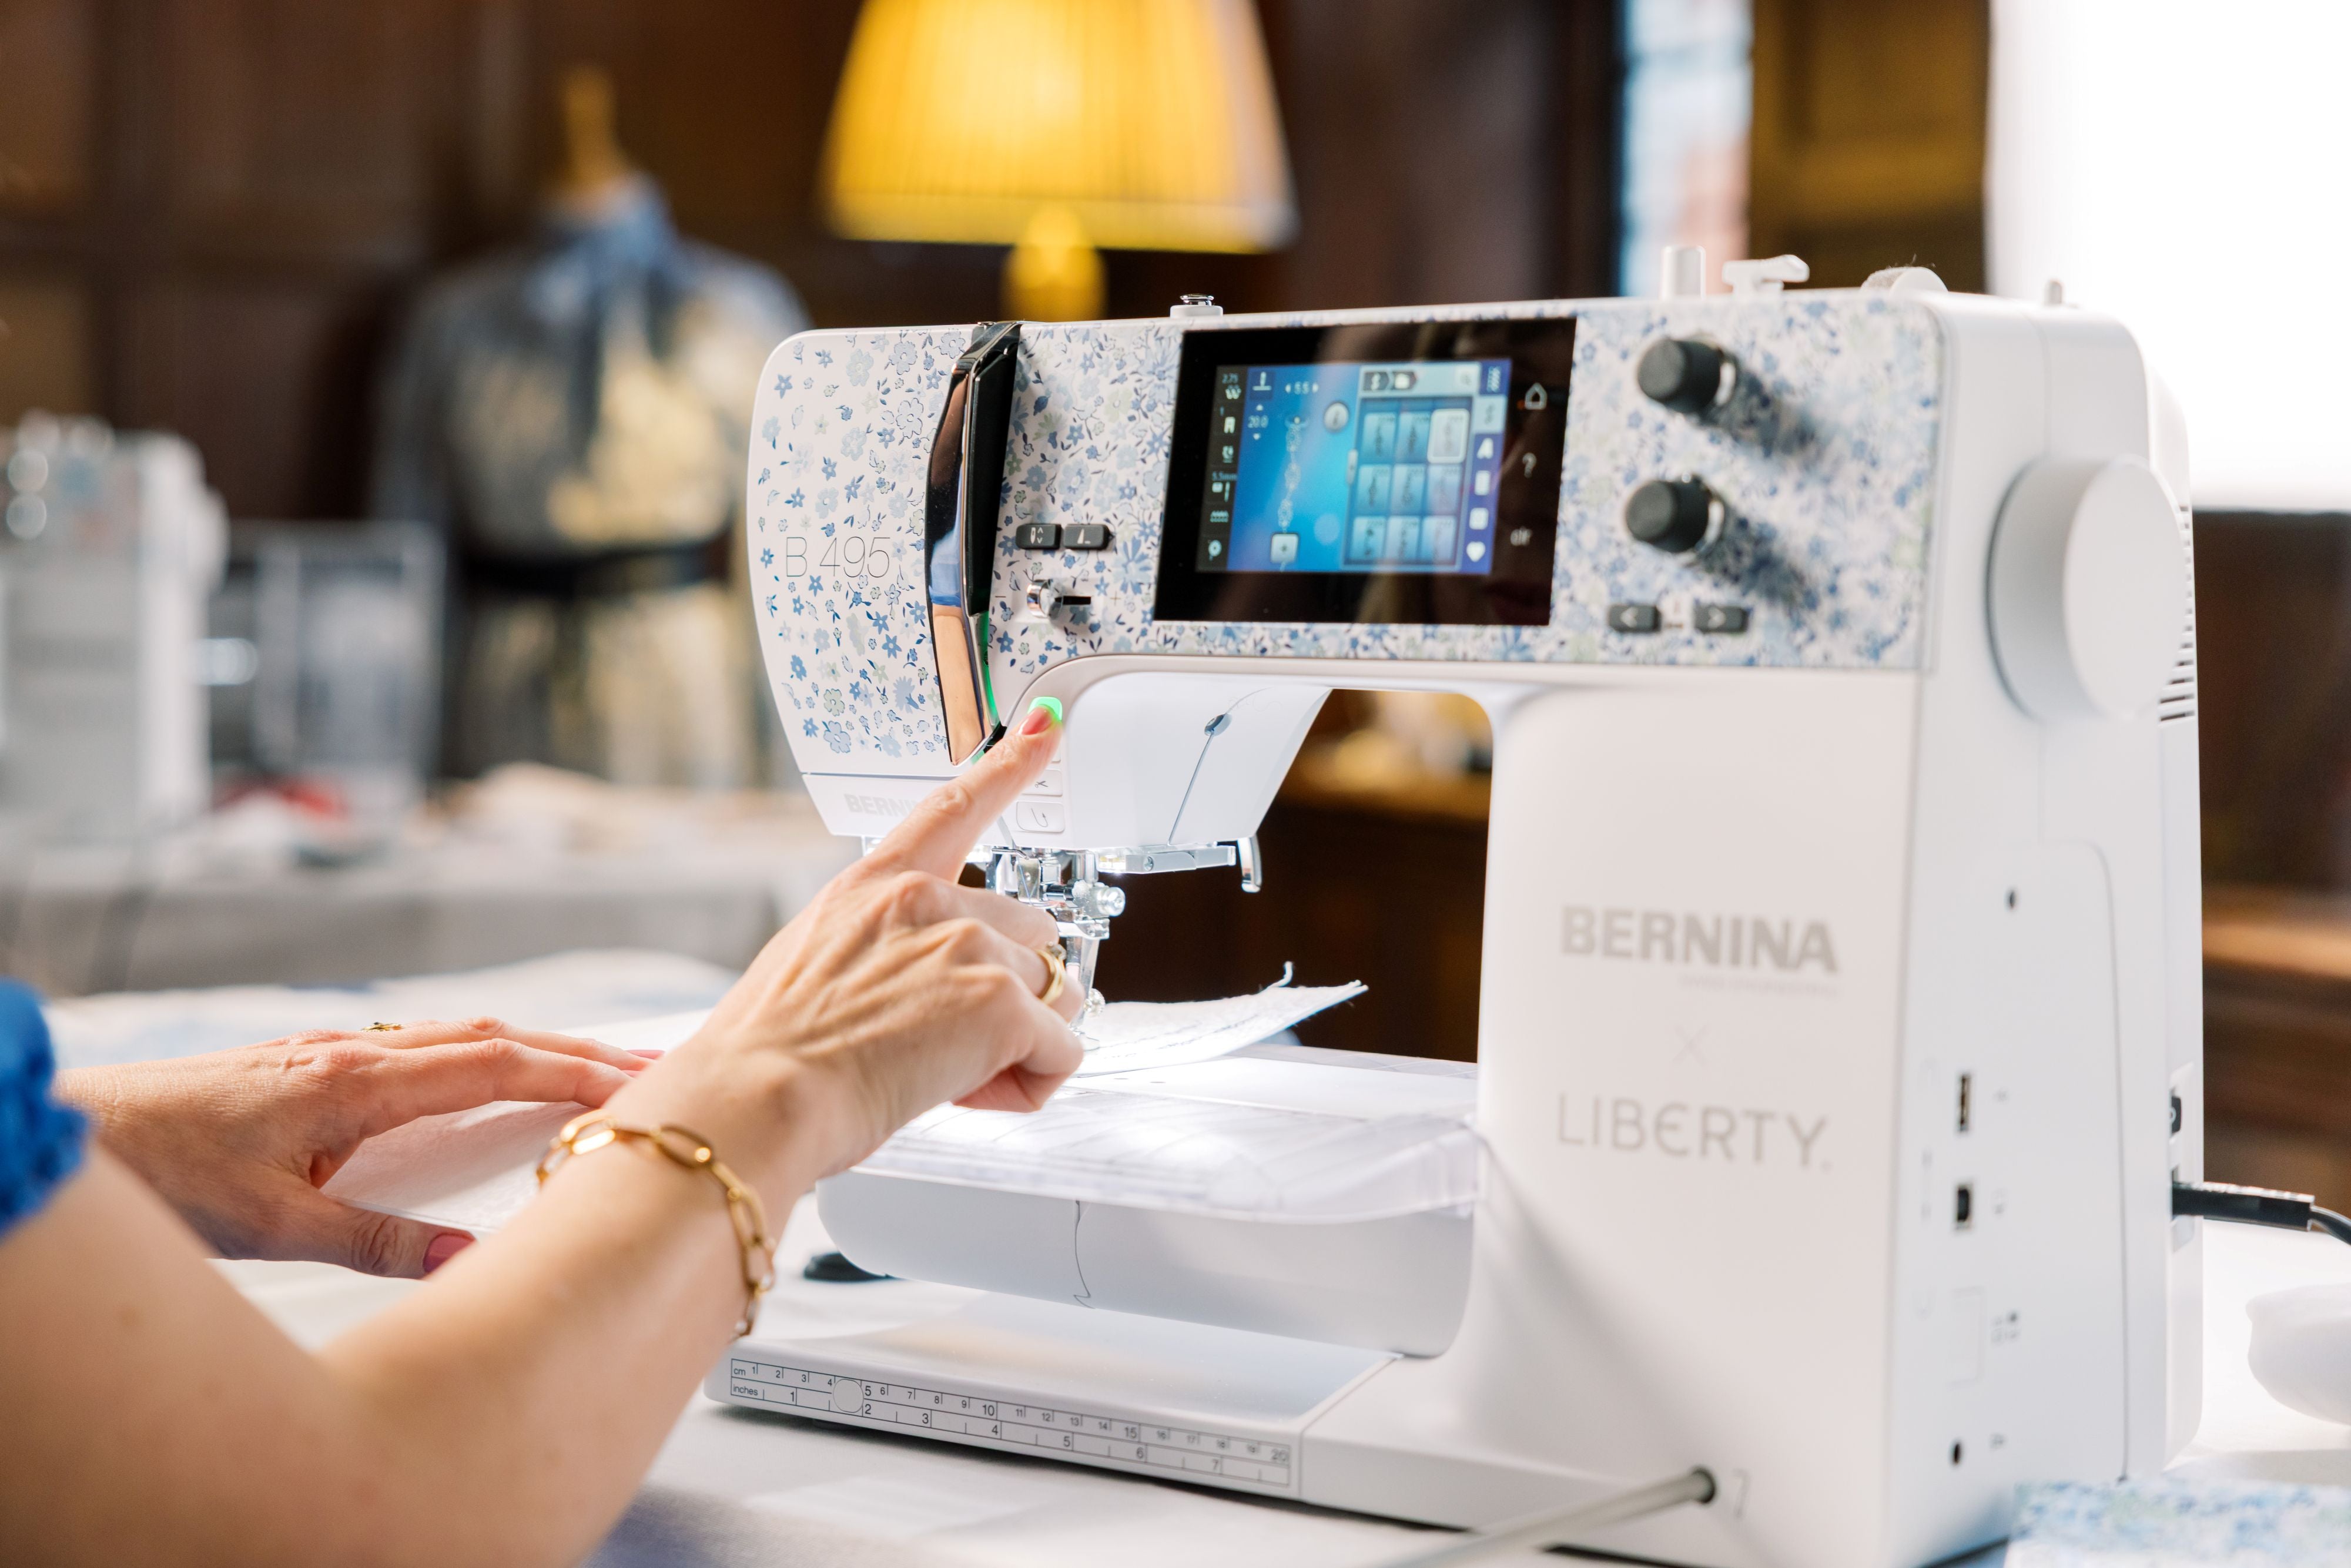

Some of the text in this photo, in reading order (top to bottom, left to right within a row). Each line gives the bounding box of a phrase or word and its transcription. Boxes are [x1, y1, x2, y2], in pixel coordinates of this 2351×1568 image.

[786, 537, 890, 578] B 495
[1560, 904, 1839, 974] BERNINA
[733, 1385, 1218, 1471] inches 1 2 3 4 5 6 7
[865, 1386, 871, 1396] 5
[962, 1400, 967, 1408] 9
[982, 1405, 994, 1416] 10
[1016, 1409, 1023, 1417] 11
[1070, 1418, 1079, 1426] 13
[1099, 1422, 1107, 1430] 14
[1125, 1427, 1137, 1439] 15
[1271, 1450, 1287, 1461] 20
